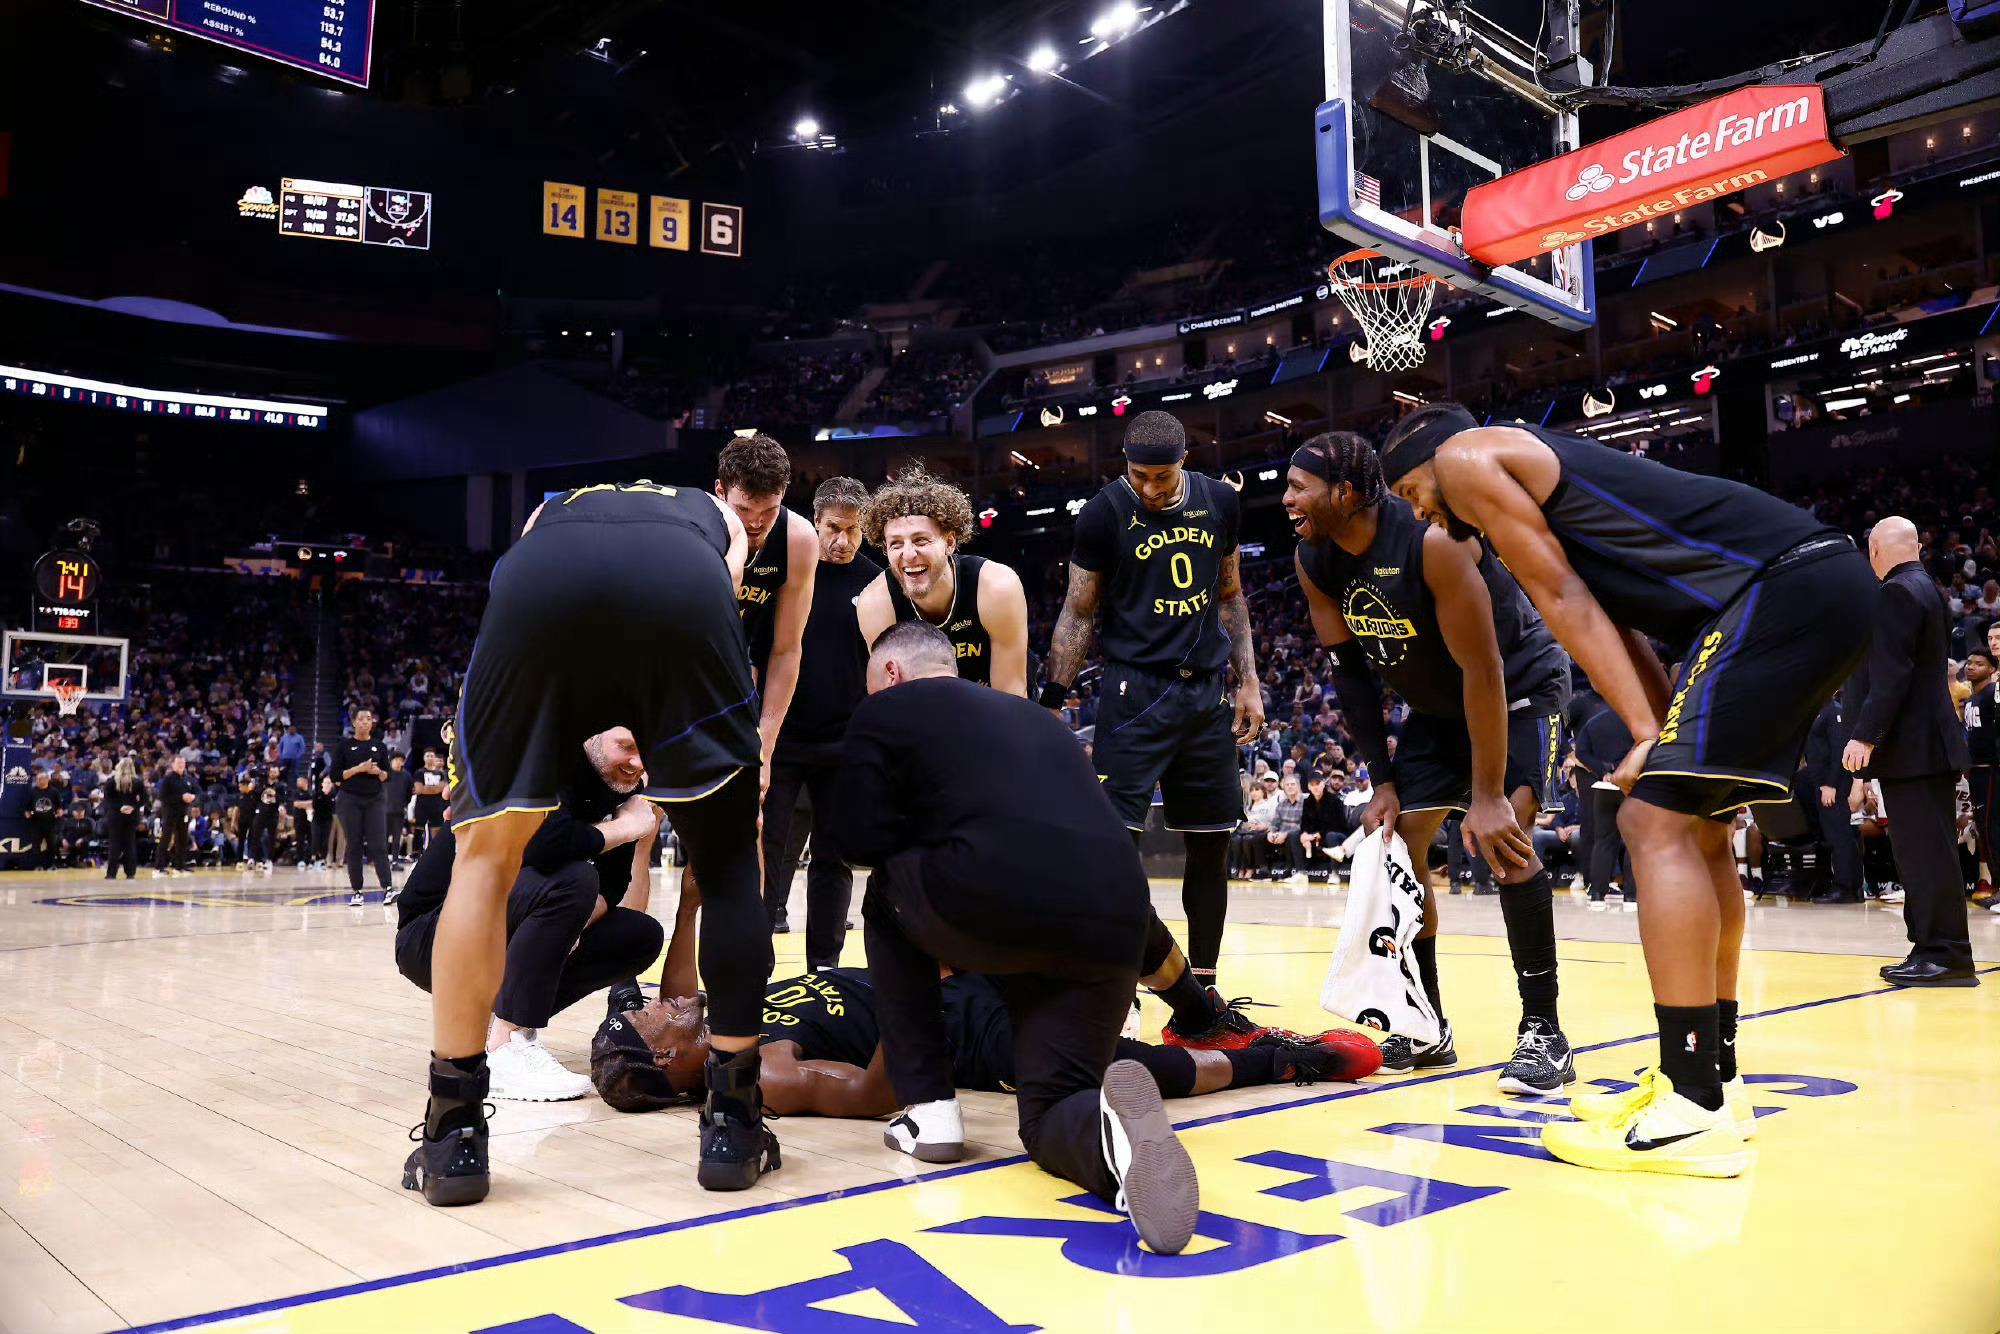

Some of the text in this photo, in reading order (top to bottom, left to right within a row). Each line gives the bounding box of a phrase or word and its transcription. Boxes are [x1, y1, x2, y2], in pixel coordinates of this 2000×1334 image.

[204, 1, 257, 24] REBOUND %
[323, 6, 345, 21] 53.7
[203, 18, 244, 37] ASSIST %
[320, 21, 344, 37] 113.7
[551, 203, 577, 231] 14
[604, 209, 630, 237] 13
[662, 217, 677, 243] 9
[710, 214, 733, 246] 6
[1190, 315, 1242, 330] CHASE CENTER
[1859, 327, 1909, 347] Sports
[1850, 342, 1898, 359] BAY AREA
[1771, 355, 1809, 369] PRESENTED
[1135, 526, 1215, 560] GOLDEN
[57, 560, 88, 577] 7:41
[1170, 552, 1193, 589] 0
[1373, 566, 1400, 577] Rakuten
[59, 575, 84, 601] 14
[737, 585, 771, 604] DEN
[52, 607, 90, 618] TISSOT
[1153, 588, 1209, 617] STATE
[798, 973, 845, 1018] STATE
